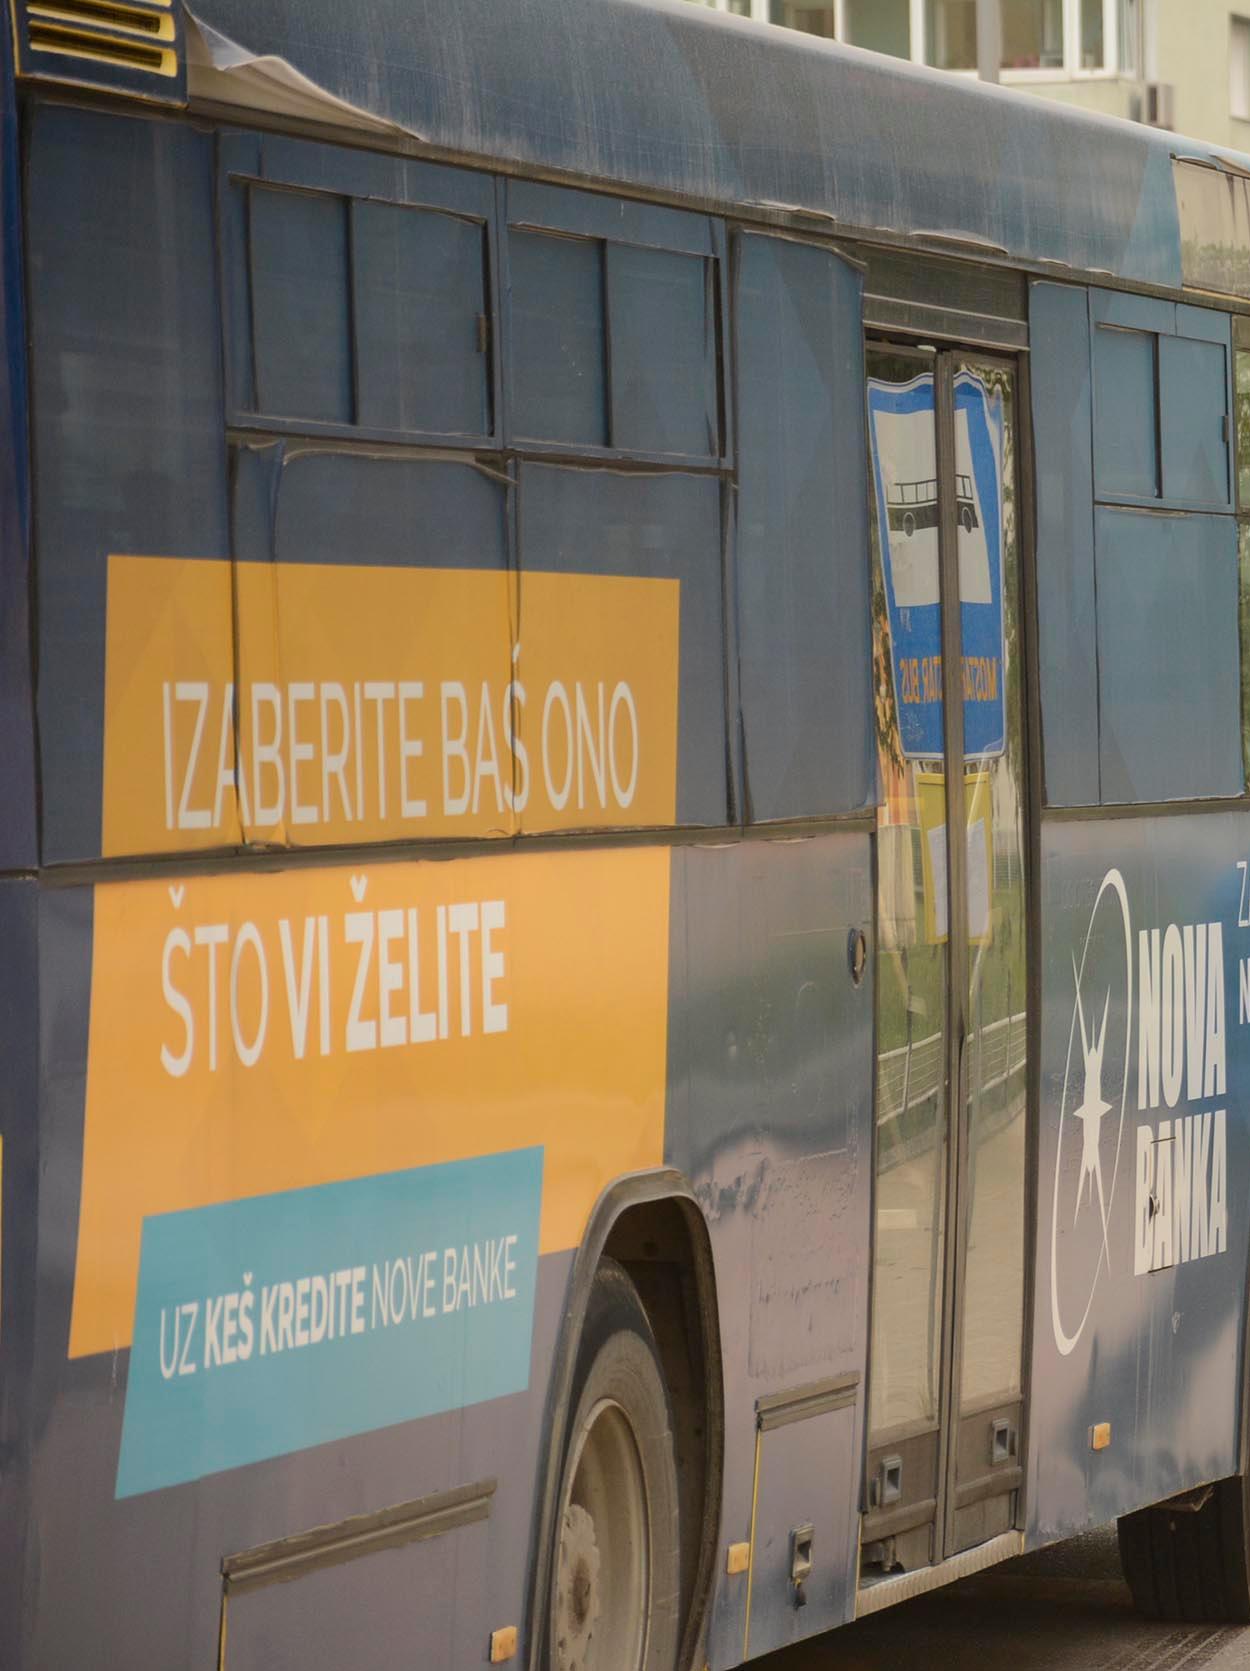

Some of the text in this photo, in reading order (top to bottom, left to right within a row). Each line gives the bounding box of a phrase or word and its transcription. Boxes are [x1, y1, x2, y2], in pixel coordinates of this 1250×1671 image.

[162, 681, 427, 830] IZABERITE
[541, 680, 639, 810] ONO
[160, 874, 508, 1077] ŠTO VI ŽELITE
[1138, 922, 1226, 1110] NOVA
[1134, 1109, 1227, 1276] BANKA
[159, 1234, 517, 1379] UZ KEŠ KREDITE NOVE BANKE
